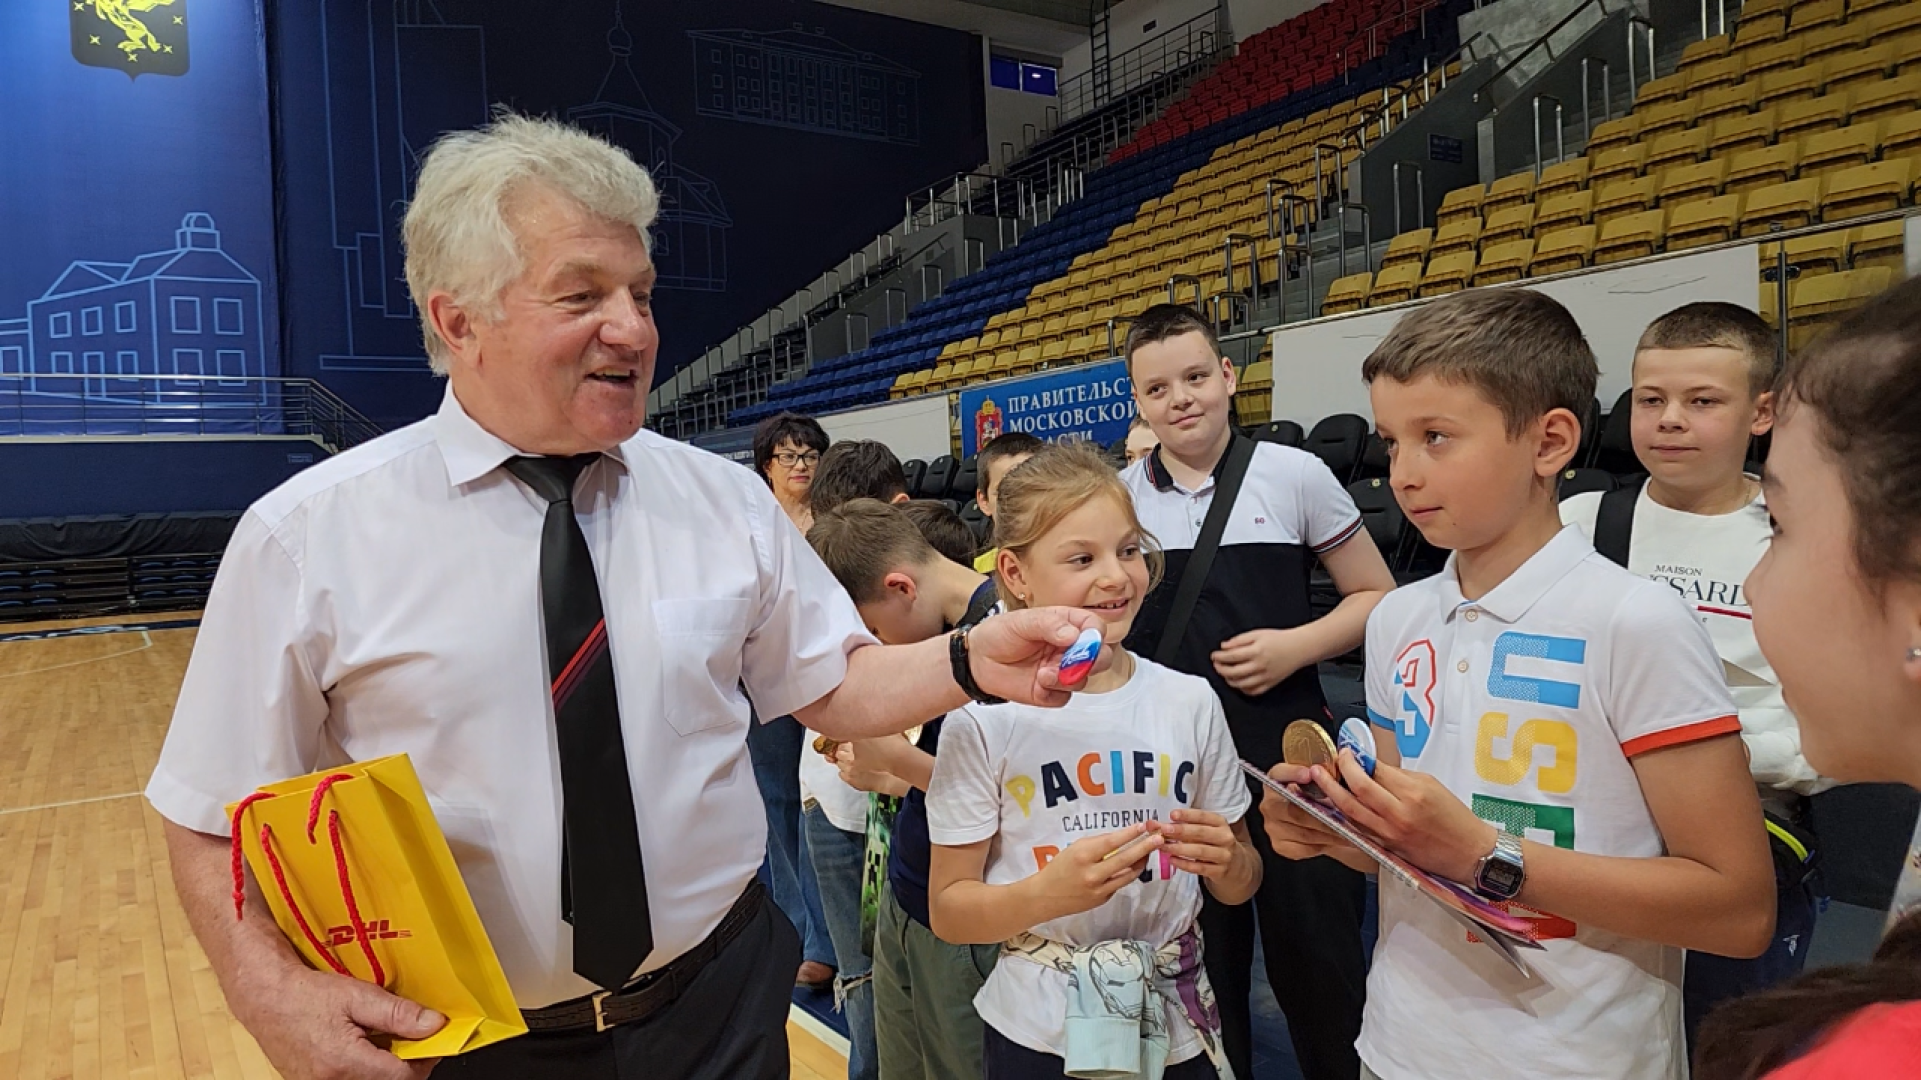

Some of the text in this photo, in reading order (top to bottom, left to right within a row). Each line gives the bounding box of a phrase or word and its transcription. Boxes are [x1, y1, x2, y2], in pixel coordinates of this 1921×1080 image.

[1008, 376, 1135, 414] ПРАВИТЕЛЬСТ
[1010, 396, 1140, 434] МОСКОВСКОЙ
[1654, 564, 1703, 576] MAISON
[1004, 750, 1195, 819] PACIFIC
[1062, 808, 1160, 832] CALIFORNIA
[327, 919, 399, 946] DHL
